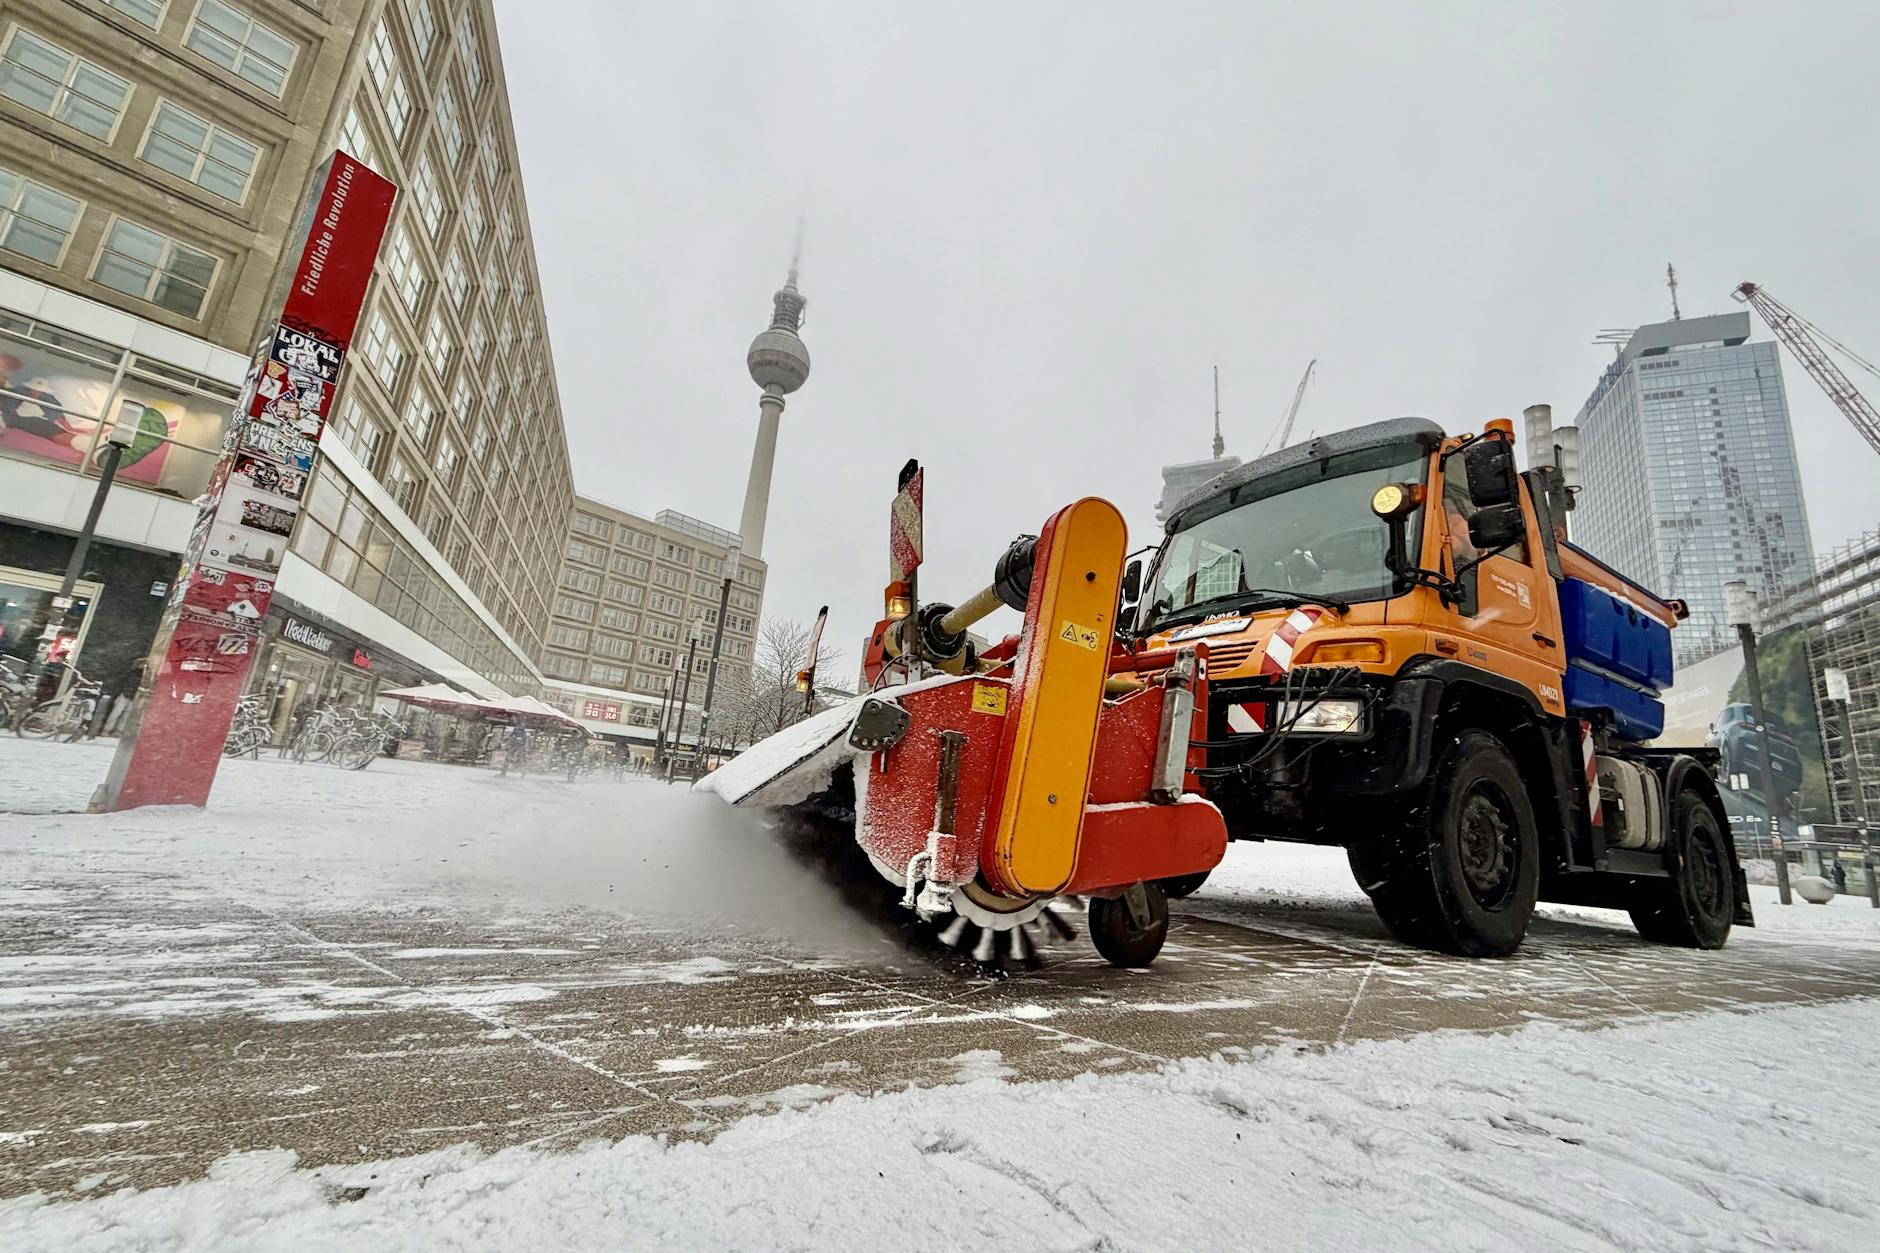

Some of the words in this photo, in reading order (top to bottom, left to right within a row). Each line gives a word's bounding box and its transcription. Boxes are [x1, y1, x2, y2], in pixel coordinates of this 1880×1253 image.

[301, 232, 333, 297] Friedliche
[323, 163, 355, 230] Revolution
[278, 327, 339, 364] LOKAL
